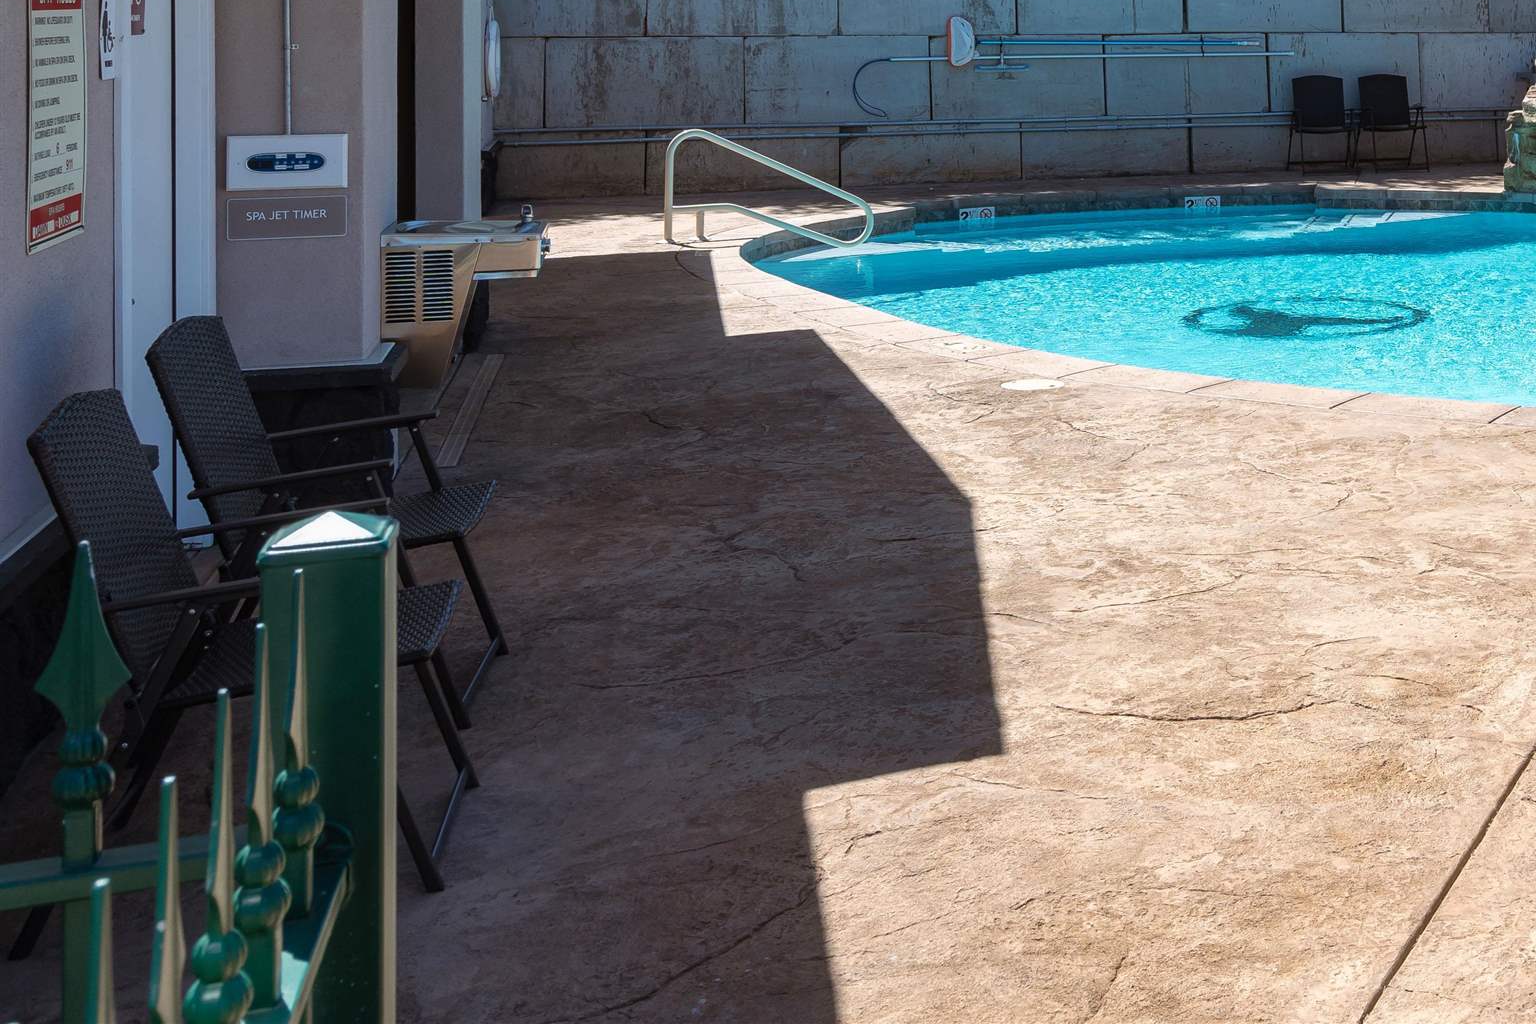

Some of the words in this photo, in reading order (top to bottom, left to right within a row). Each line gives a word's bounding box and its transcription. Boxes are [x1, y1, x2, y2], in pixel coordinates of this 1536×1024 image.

[246, 211, 266, 222] SPA
[268, 210, 290, 221] JET
[293, 208, 328, 220] TIMER
